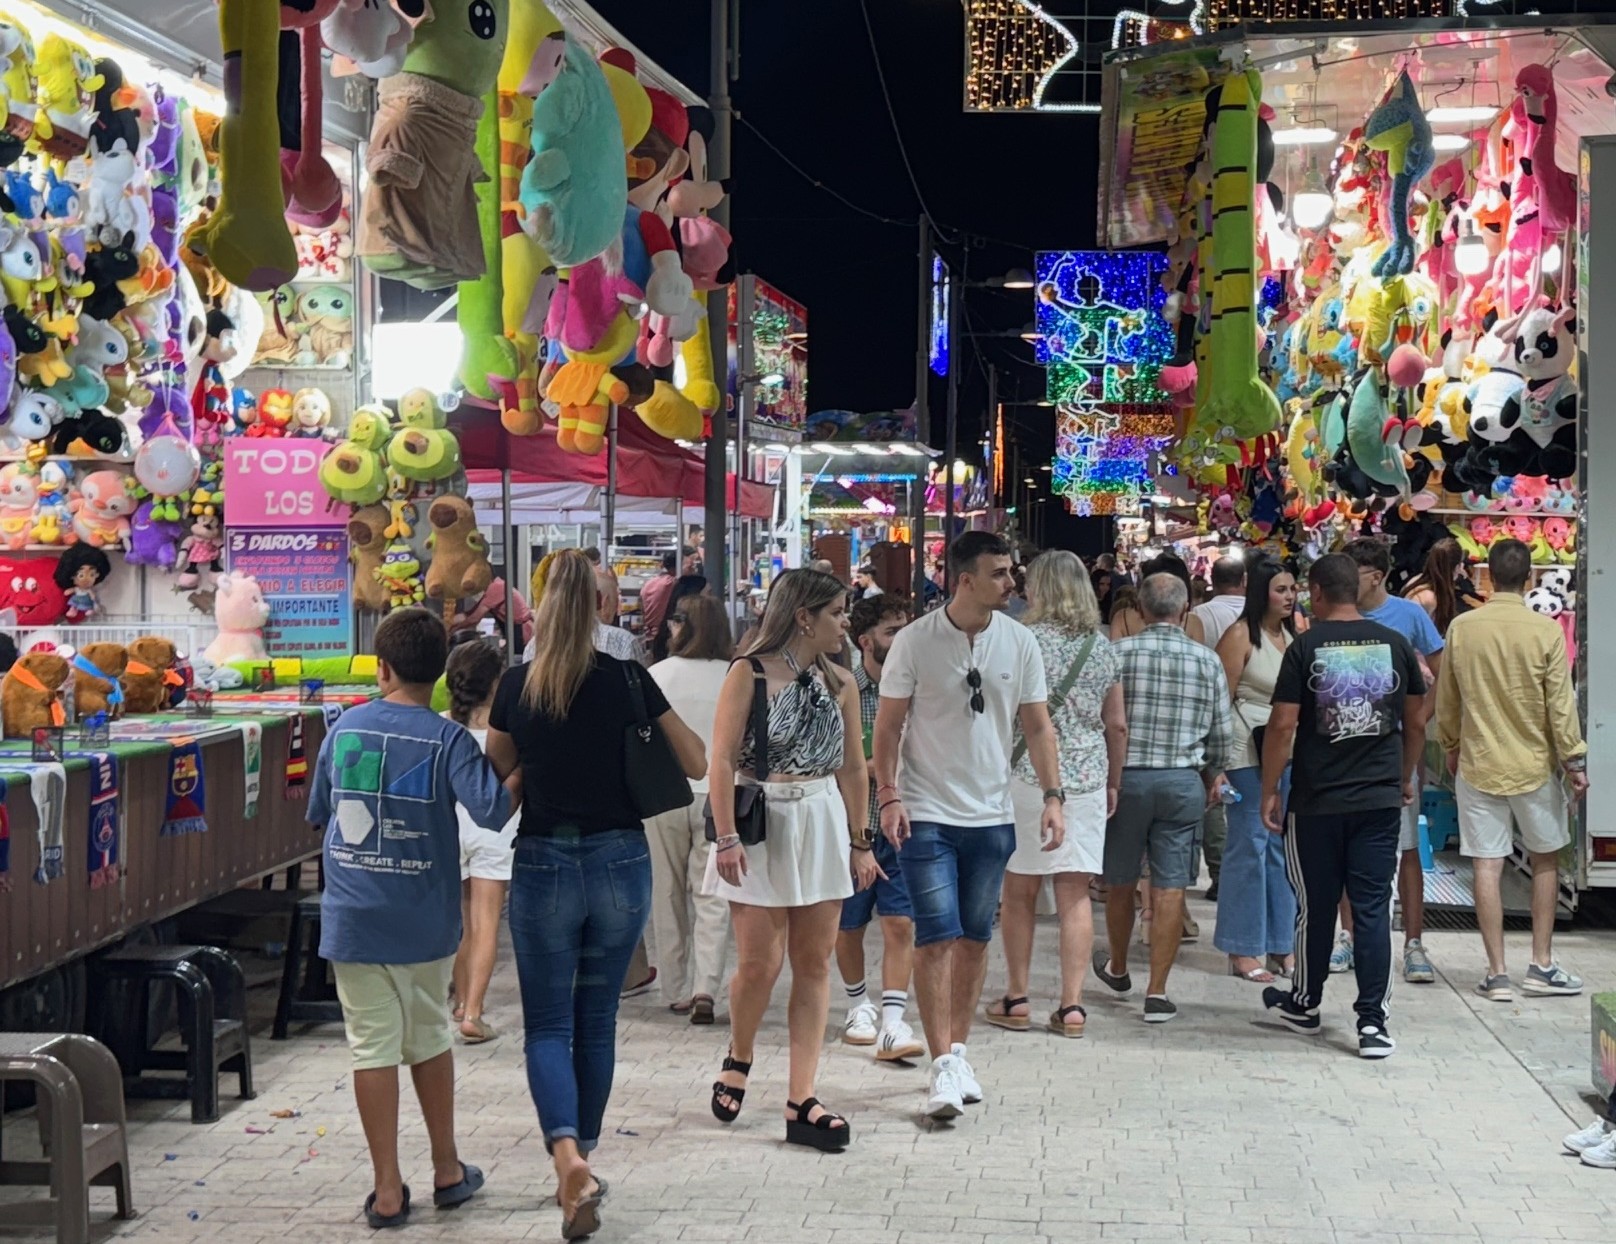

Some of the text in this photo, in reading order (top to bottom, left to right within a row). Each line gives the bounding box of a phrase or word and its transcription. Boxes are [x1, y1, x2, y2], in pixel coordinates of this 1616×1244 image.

[232, 449, 324, 475] TOD
[264, 490, 315, 516] LOS
[231, 533, 318, 552] 3 DARDOS
[258, 578, 347, 593] MIO A ELEGIR
[272, 599, 339, 613] IMPORTANTE
[329, 850, 354, 862] THINK
[360, 856, 394, 867] CREATE
[401, 860, 433, 870] REPEAT
